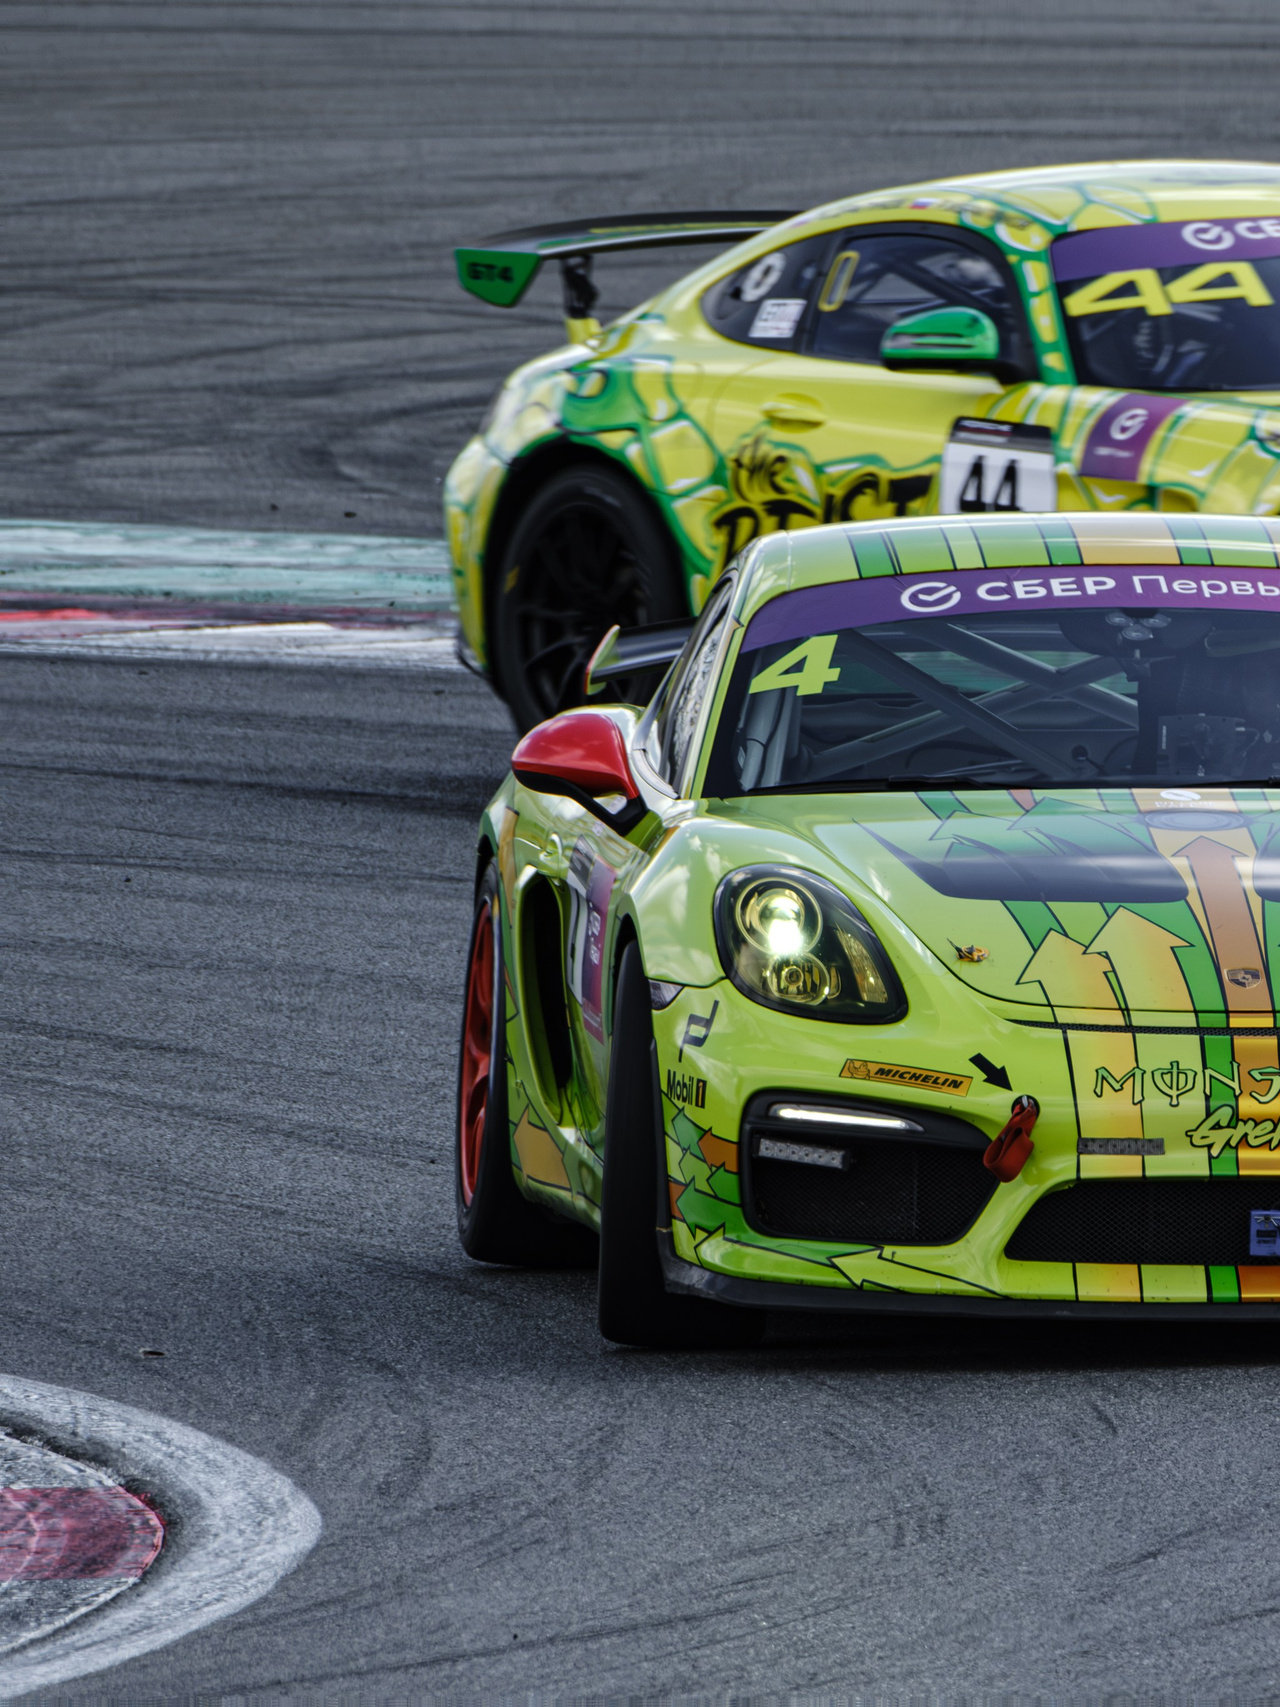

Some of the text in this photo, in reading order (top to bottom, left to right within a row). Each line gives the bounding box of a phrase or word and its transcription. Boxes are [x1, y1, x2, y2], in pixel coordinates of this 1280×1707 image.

[1063, 261, 1275, 317] 44
[959, 455, 1022, 512] 44
[977, 576, 1117, 601] СБЕР
[748, 634, 841, 696] 4
[666, 1068, 694, 1106] Mobil
[874, 1067, 965, 1089] MICHELIN
